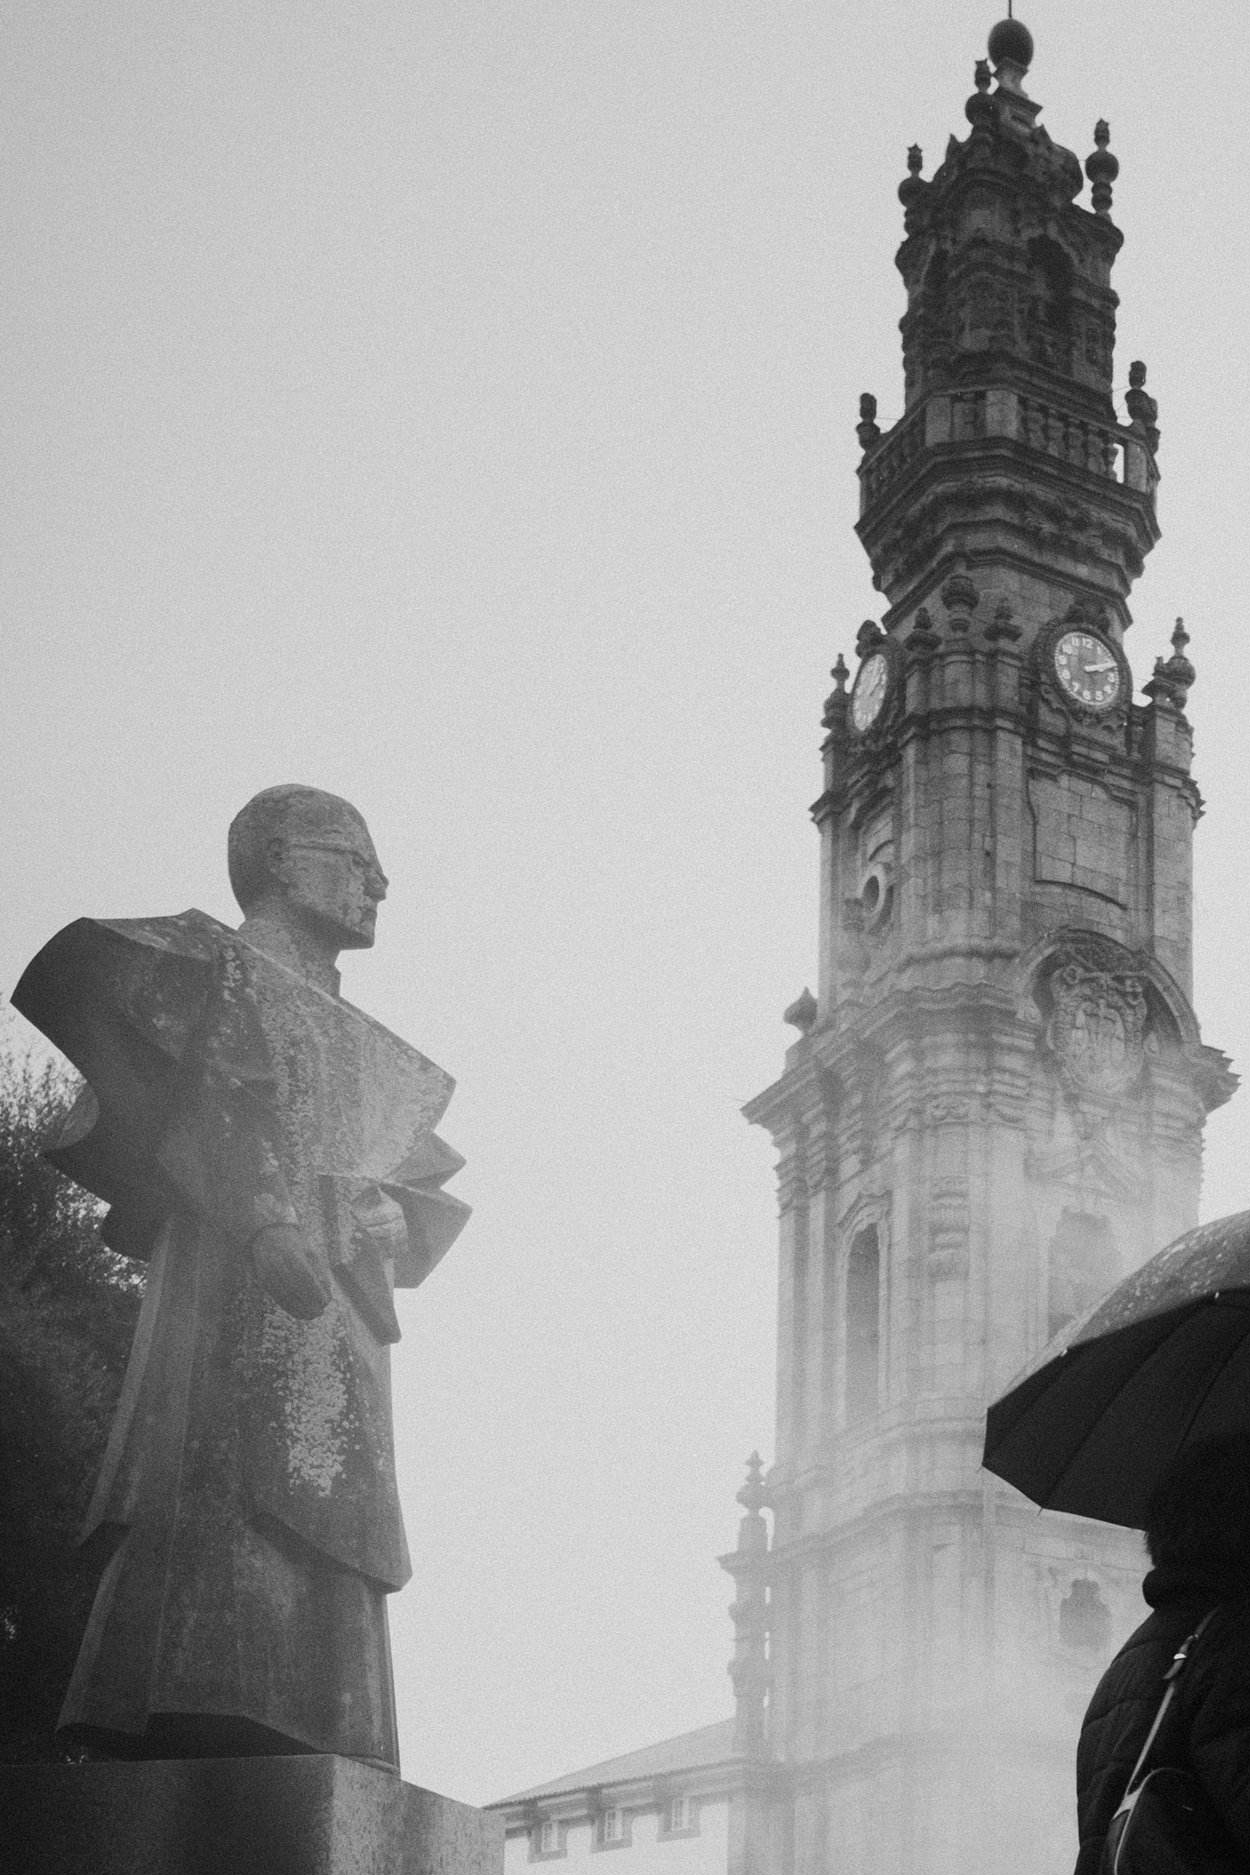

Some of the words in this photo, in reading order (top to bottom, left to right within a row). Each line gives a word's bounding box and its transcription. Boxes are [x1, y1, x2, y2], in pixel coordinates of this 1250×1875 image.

[1082, 637, 1093, 649] 12
[1071, 682, 1079, 692] 7
[1082, 690, 1091, 700] 6
[1095, 690, 1103, 701] 5
